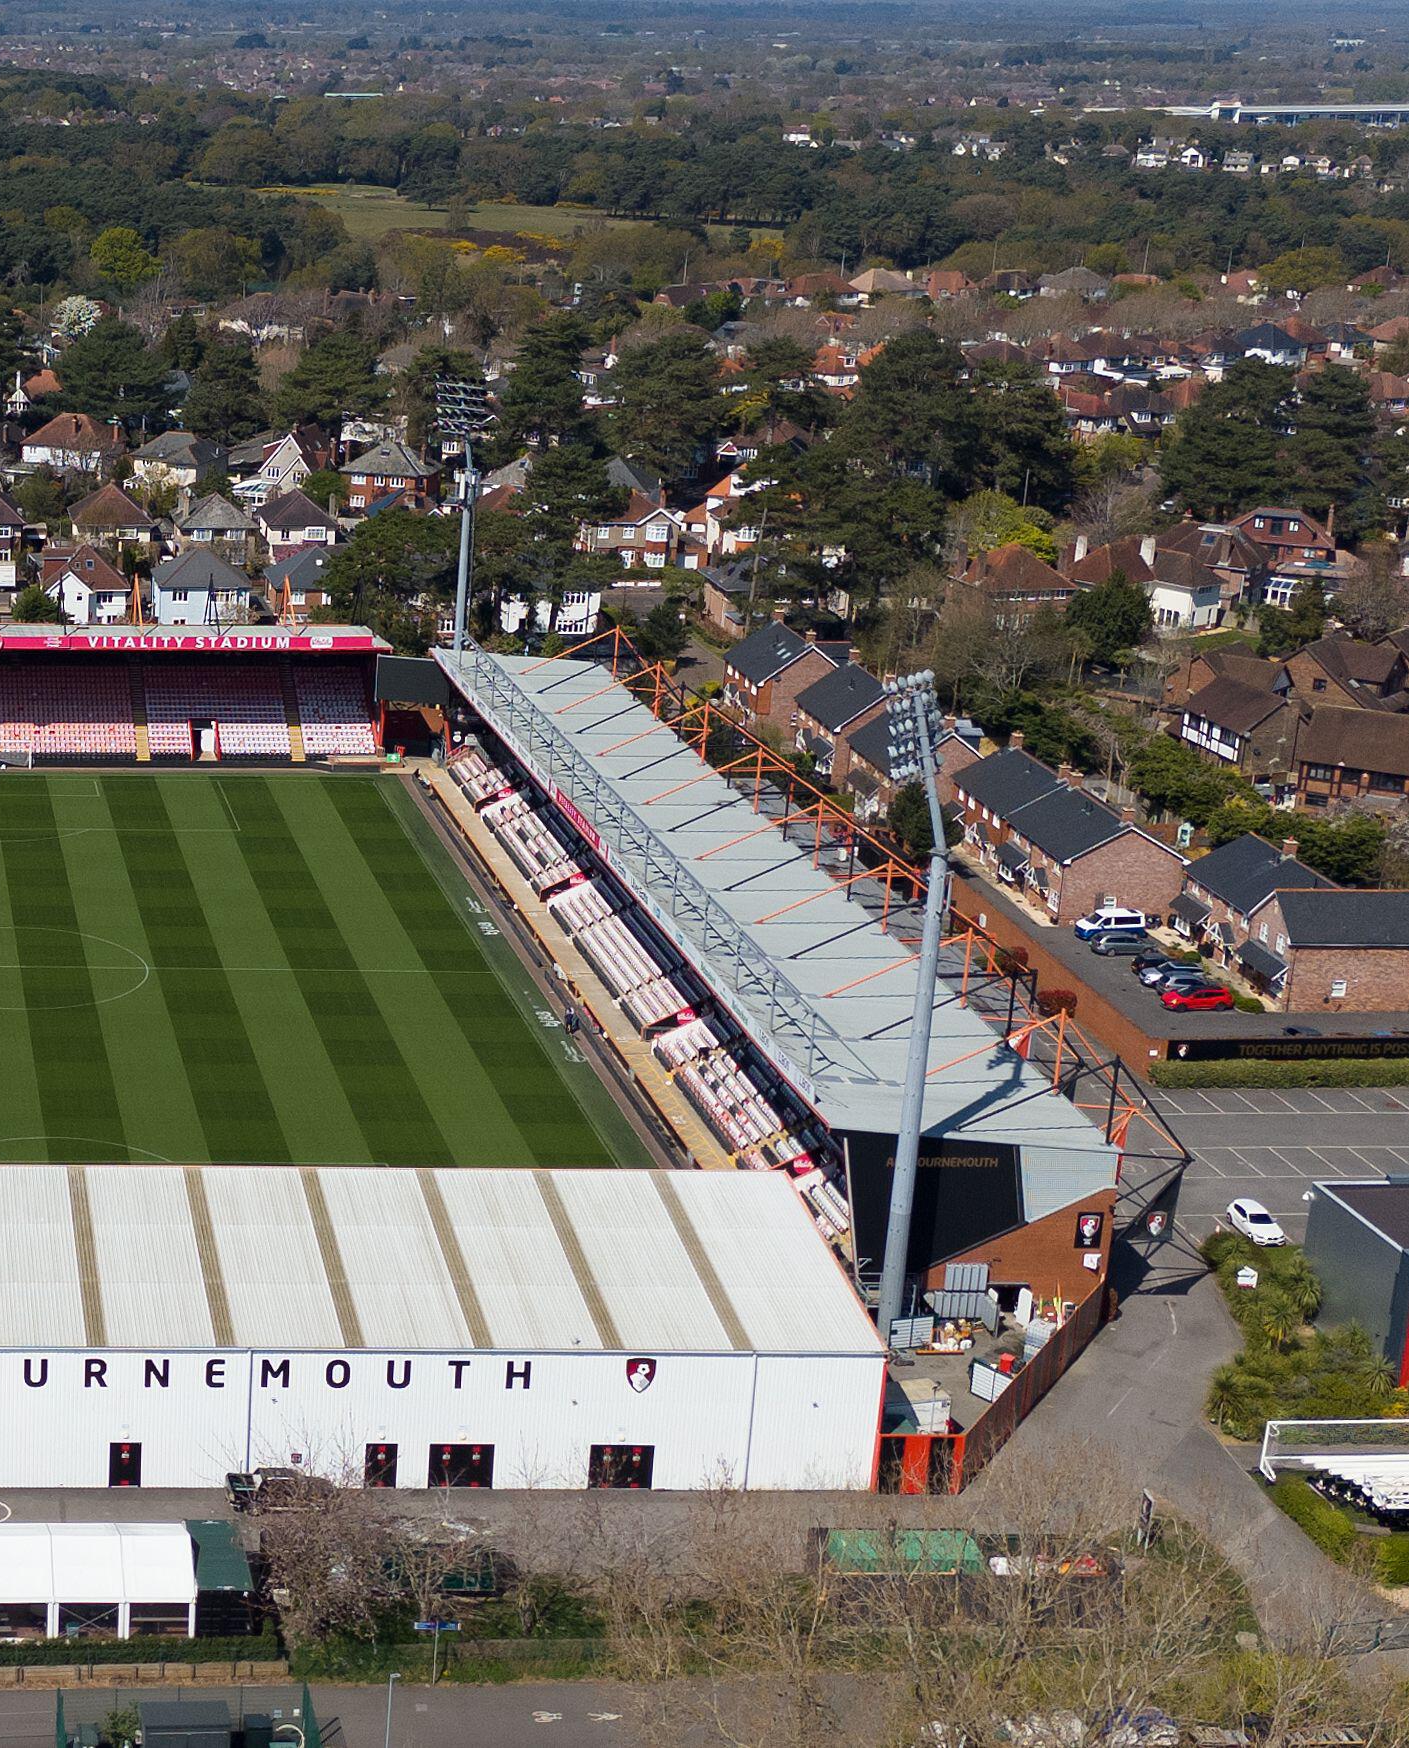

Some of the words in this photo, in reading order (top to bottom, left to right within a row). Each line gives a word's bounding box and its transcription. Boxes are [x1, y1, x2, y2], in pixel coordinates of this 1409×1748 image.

[88, 636, 185, 648] VITALITY
[195, 637, 290, 649] STADIUM
[1240, 1044, 1302, 1056] TOGETHER
[1303, 1044, 1368, 1055] ANYTHING
[1370, 1043, 1381, 1054] IS
[1383, 1043, 1409, 1054] POS
[917, 1157, 999, 1168] OURNEMOUTH
